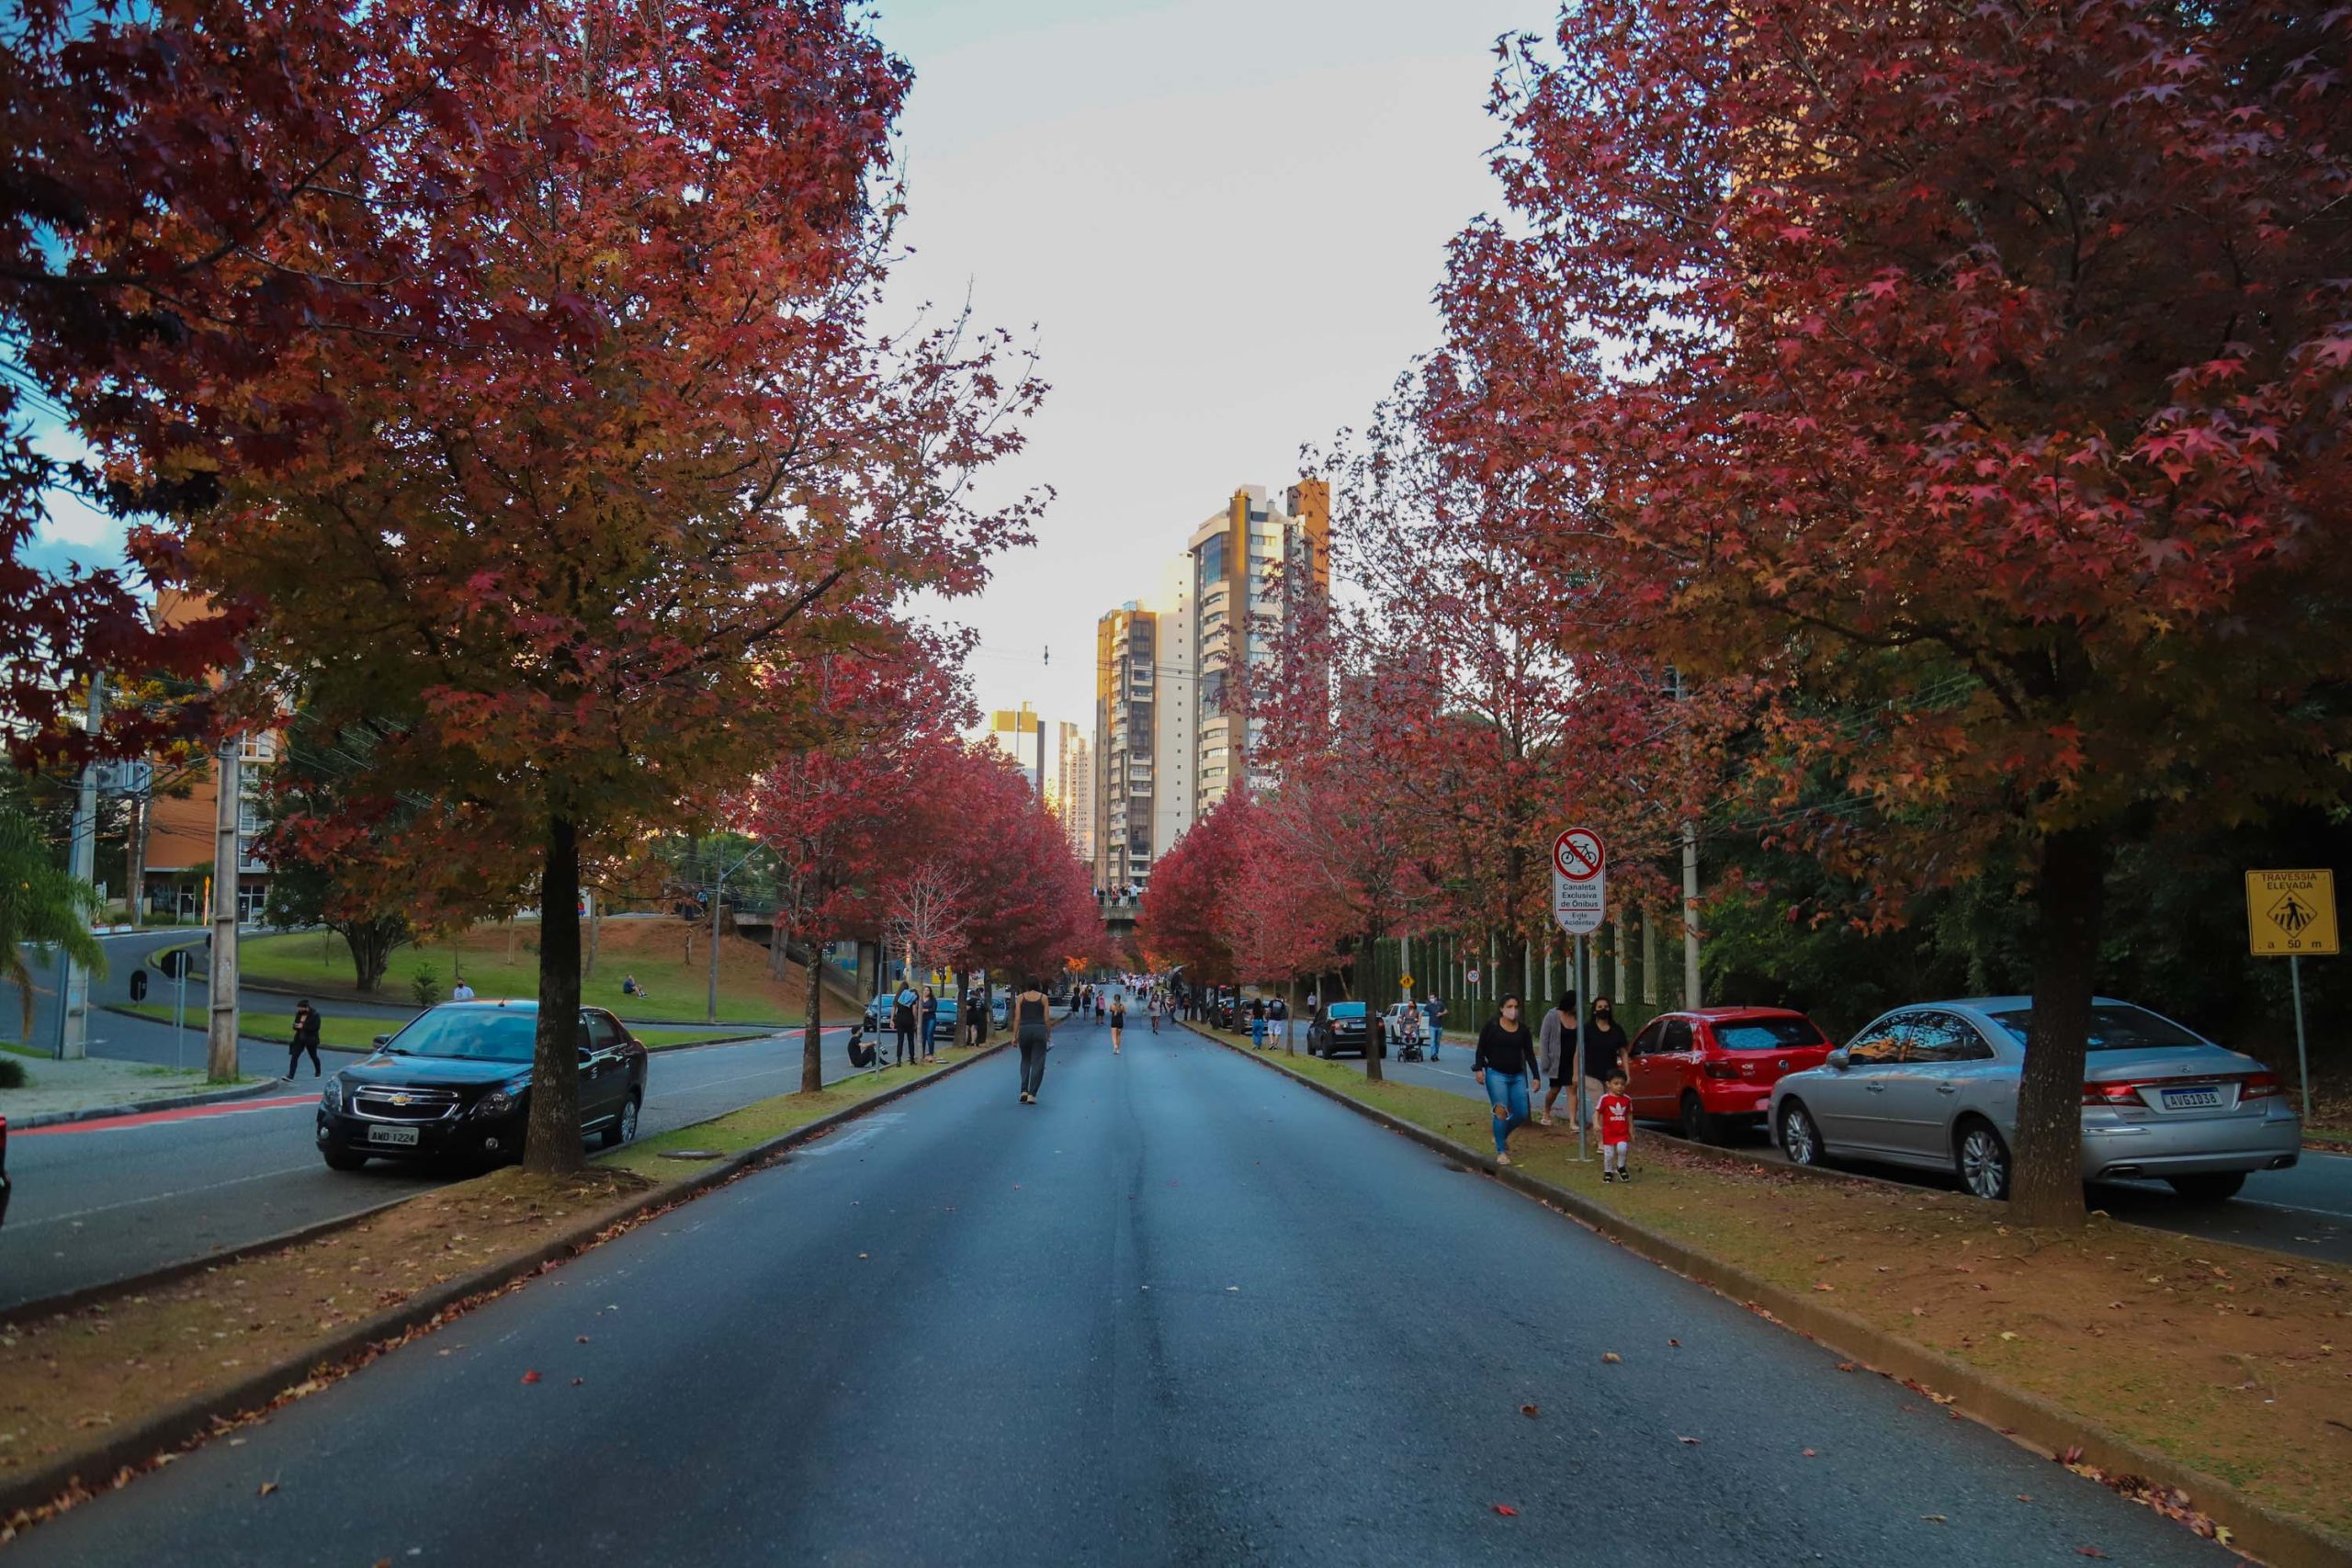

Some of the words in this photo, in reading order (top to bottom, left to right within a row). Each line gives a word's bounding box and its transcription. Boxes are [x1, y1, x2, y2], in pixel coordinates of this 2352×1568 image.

[2262, 873, 2317, 882] TRAVESSIA
[2267, 882, 2313, 890] ELEVADA
[2288, 940, 2301, 949] 50
[2170, 1093, 2217, 1106] AVG1D38
